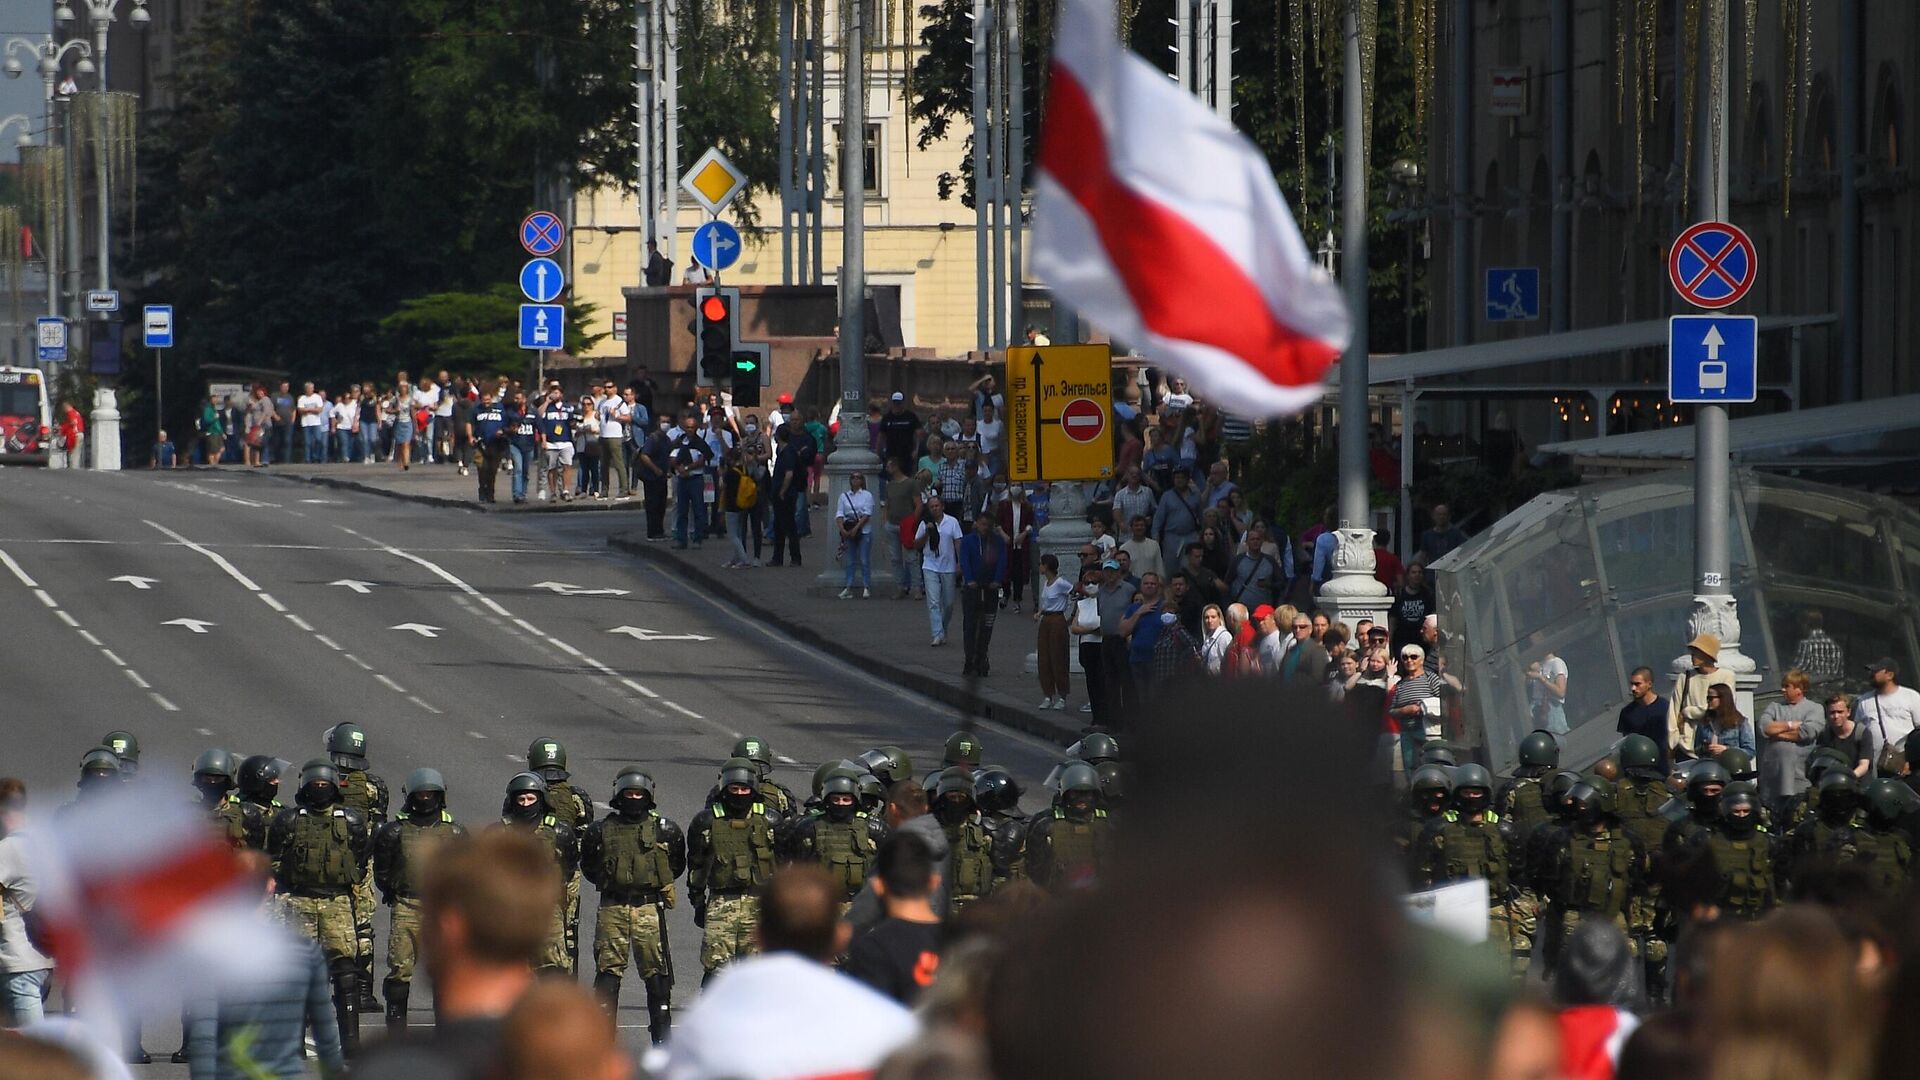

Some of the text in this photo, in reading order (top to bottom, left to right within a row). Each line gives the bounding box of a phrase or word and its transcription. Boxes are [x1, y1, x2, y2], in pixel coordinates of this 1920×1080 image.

[1043, 380, 1107, 400] ул. Энгельса
[1014, 377, 1030, 475] пр. Независимости
[1706, 574, 1719, 585] 96
